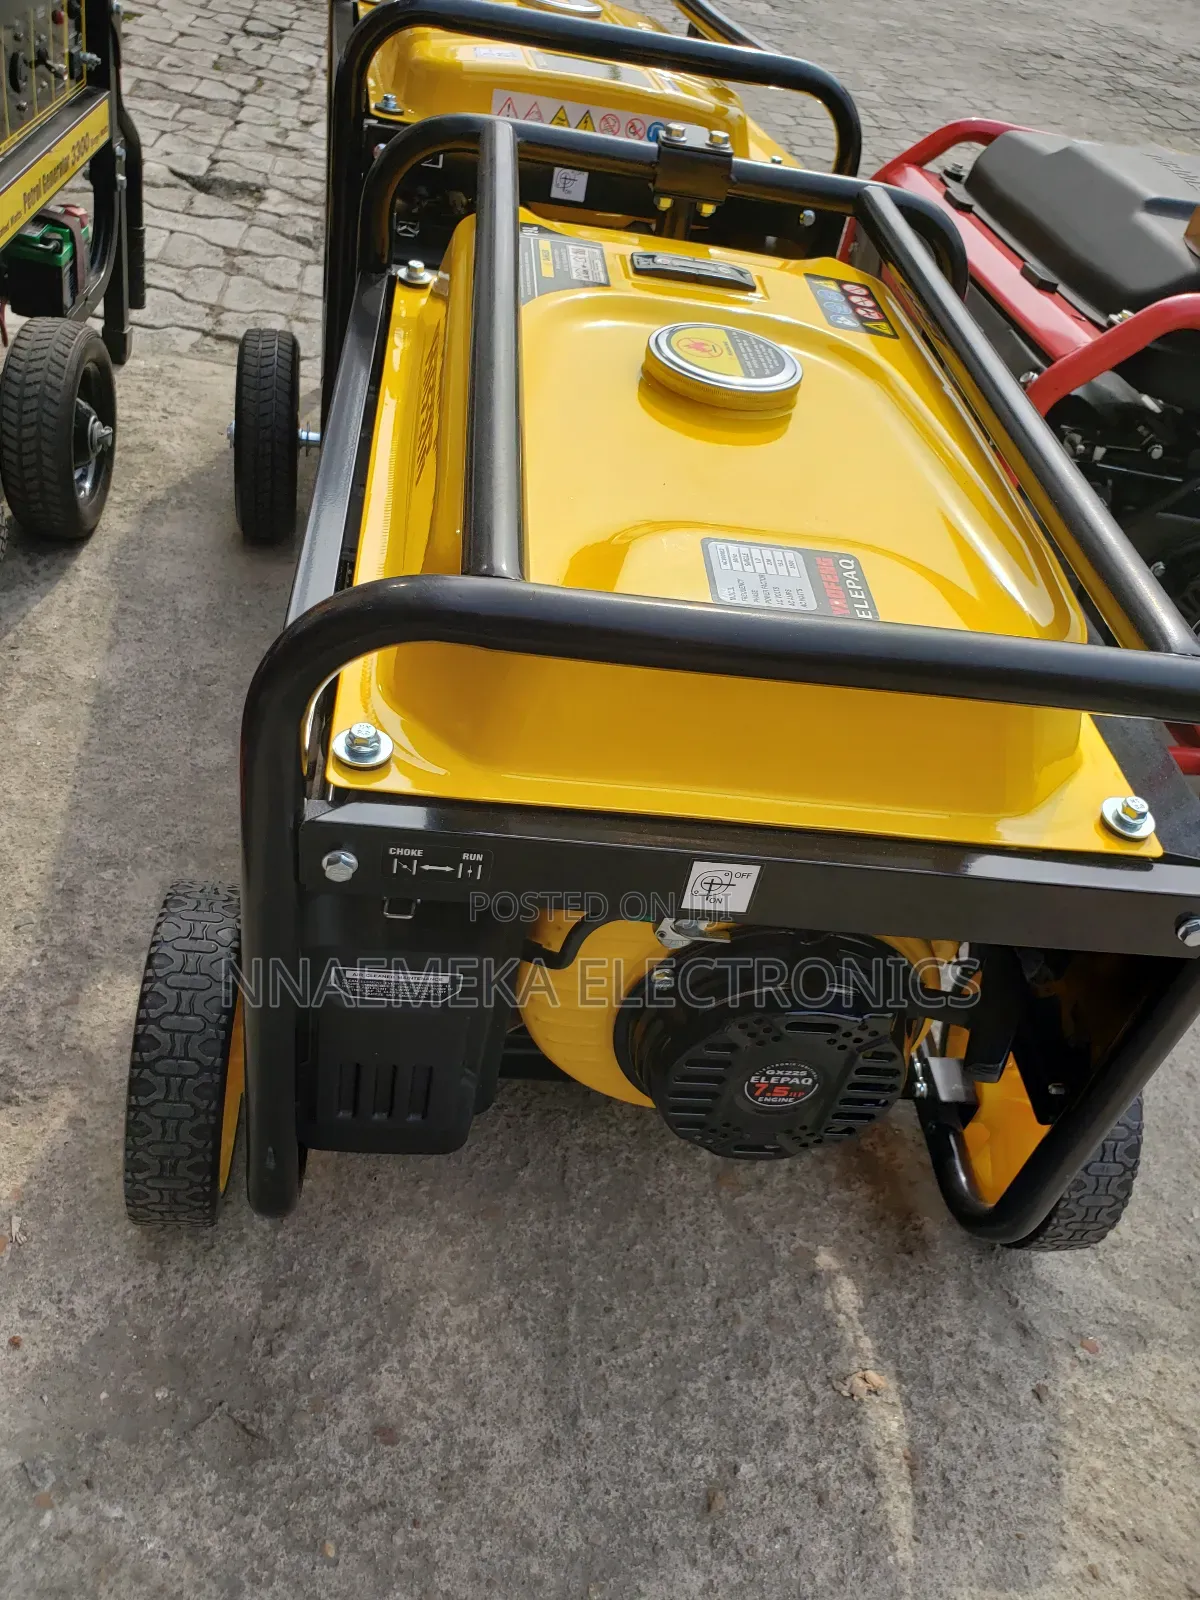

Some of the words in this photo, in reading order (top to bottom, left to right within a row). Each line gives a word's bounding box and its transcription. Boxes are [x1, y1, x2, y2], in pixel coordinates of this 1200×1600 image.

[838, 558, 873, 620] ELEPAQ
[388, 847, 424, 857] CHOKE
[462, 852, 484, 862] RUN
[734, 871, 753, 879] OFF
[397, 974, 444, 982] MAINTENANCE
[750, 1075, 813, 1086] ELEPAQ
[753, 1083, 792, 1097] 7.5
